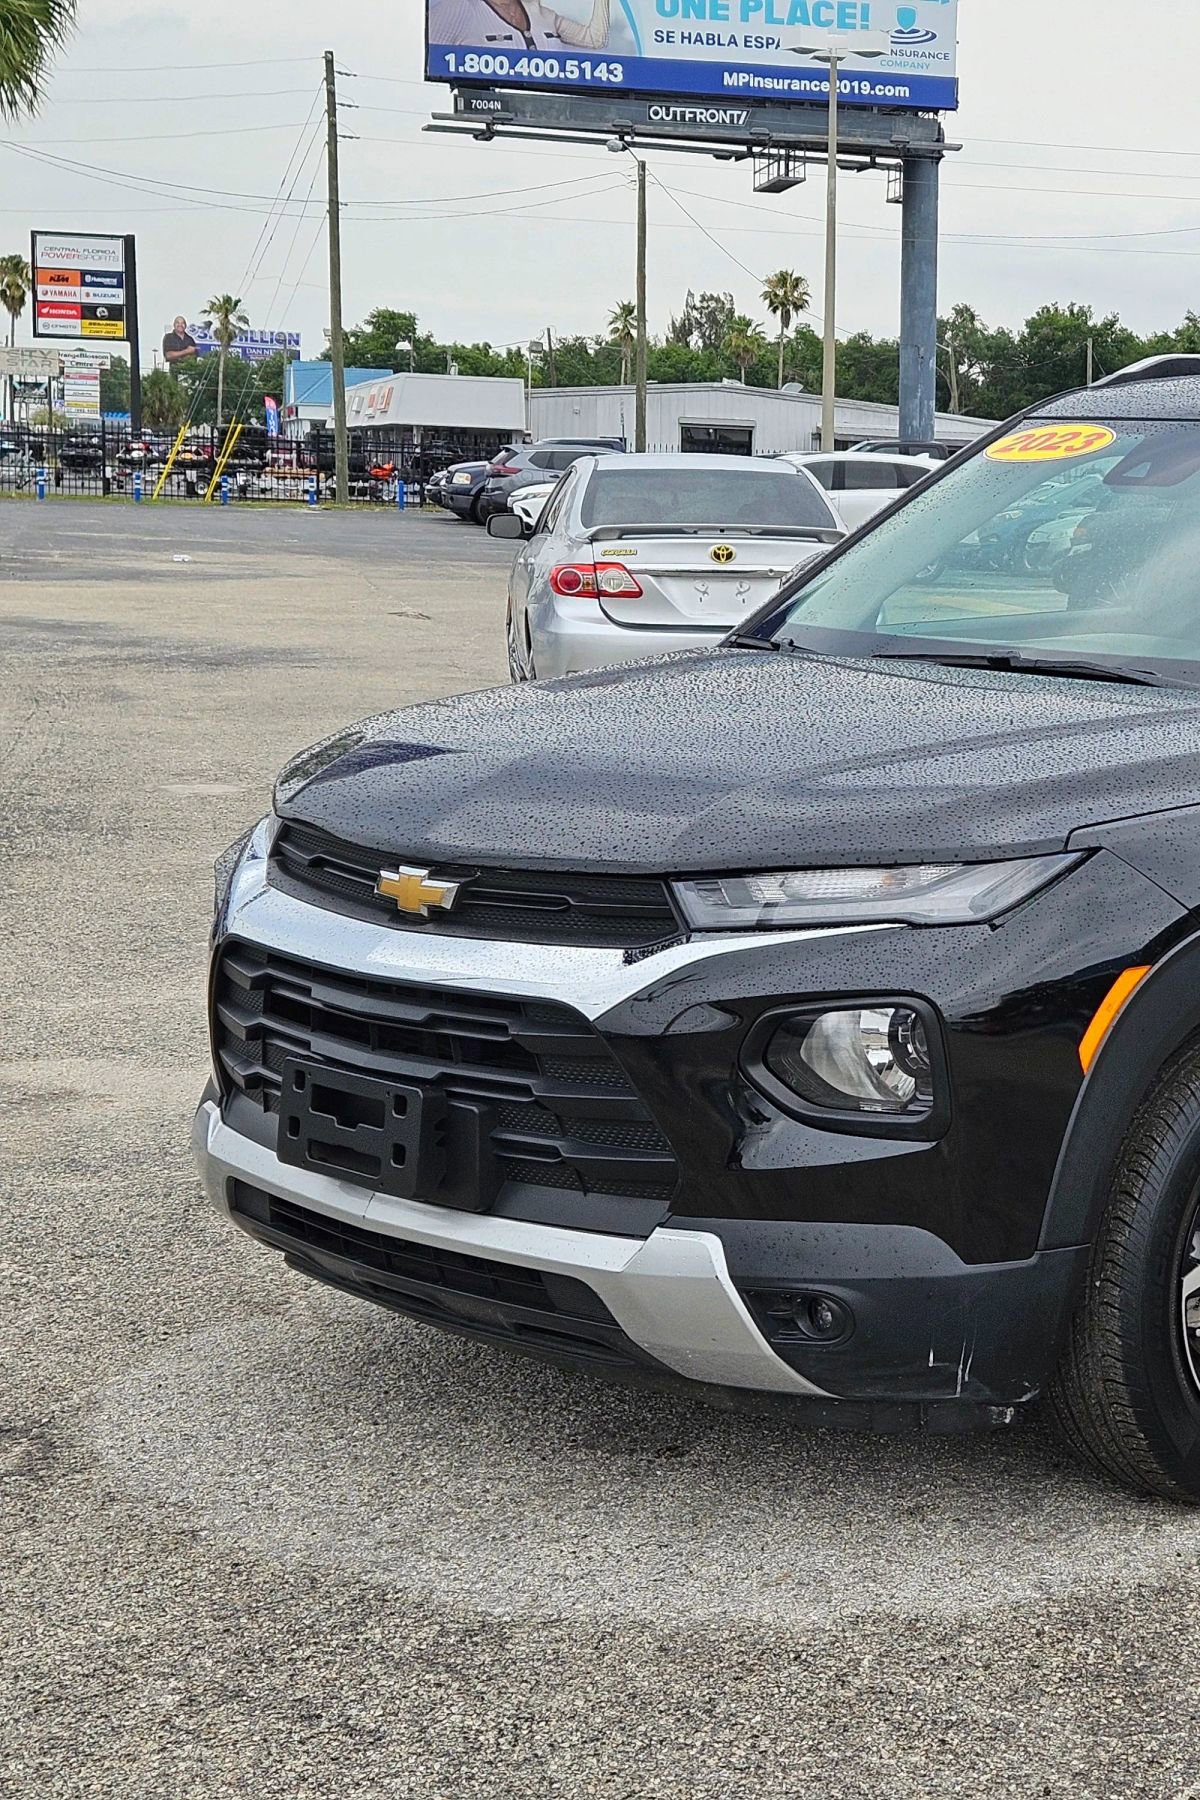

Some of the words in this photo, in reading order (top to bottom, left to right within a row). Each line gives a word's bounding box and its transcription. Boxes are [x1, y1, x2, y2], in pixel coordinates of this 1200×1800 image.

[656, 0, 729, 21] ONE
[740, 0, 870, 29] PLACE!
[654, 30, 676, 44] SE
[680, 31, 739, 47] HABLA
[743, 34, 781, 50] ESP
[890, 48, 951, 61] NSURANCE
[444, 53, 624, 83] 1.800.400.5143
[880, 59, 930, 70] COMPANY
[470, 99, 502, 110] 7004N
[43, 246, 81, 254] CENTRAL
[40, 251, 119, 262] POWERSPORTS
[48, 274, 70, 283] KTM
[49, 289, 77, 298] YAMAHA
[48, 308, 78, 316] HONDA
[7, 359, 52, 368] STAR
[990, 431, 1108, 454] 2023
